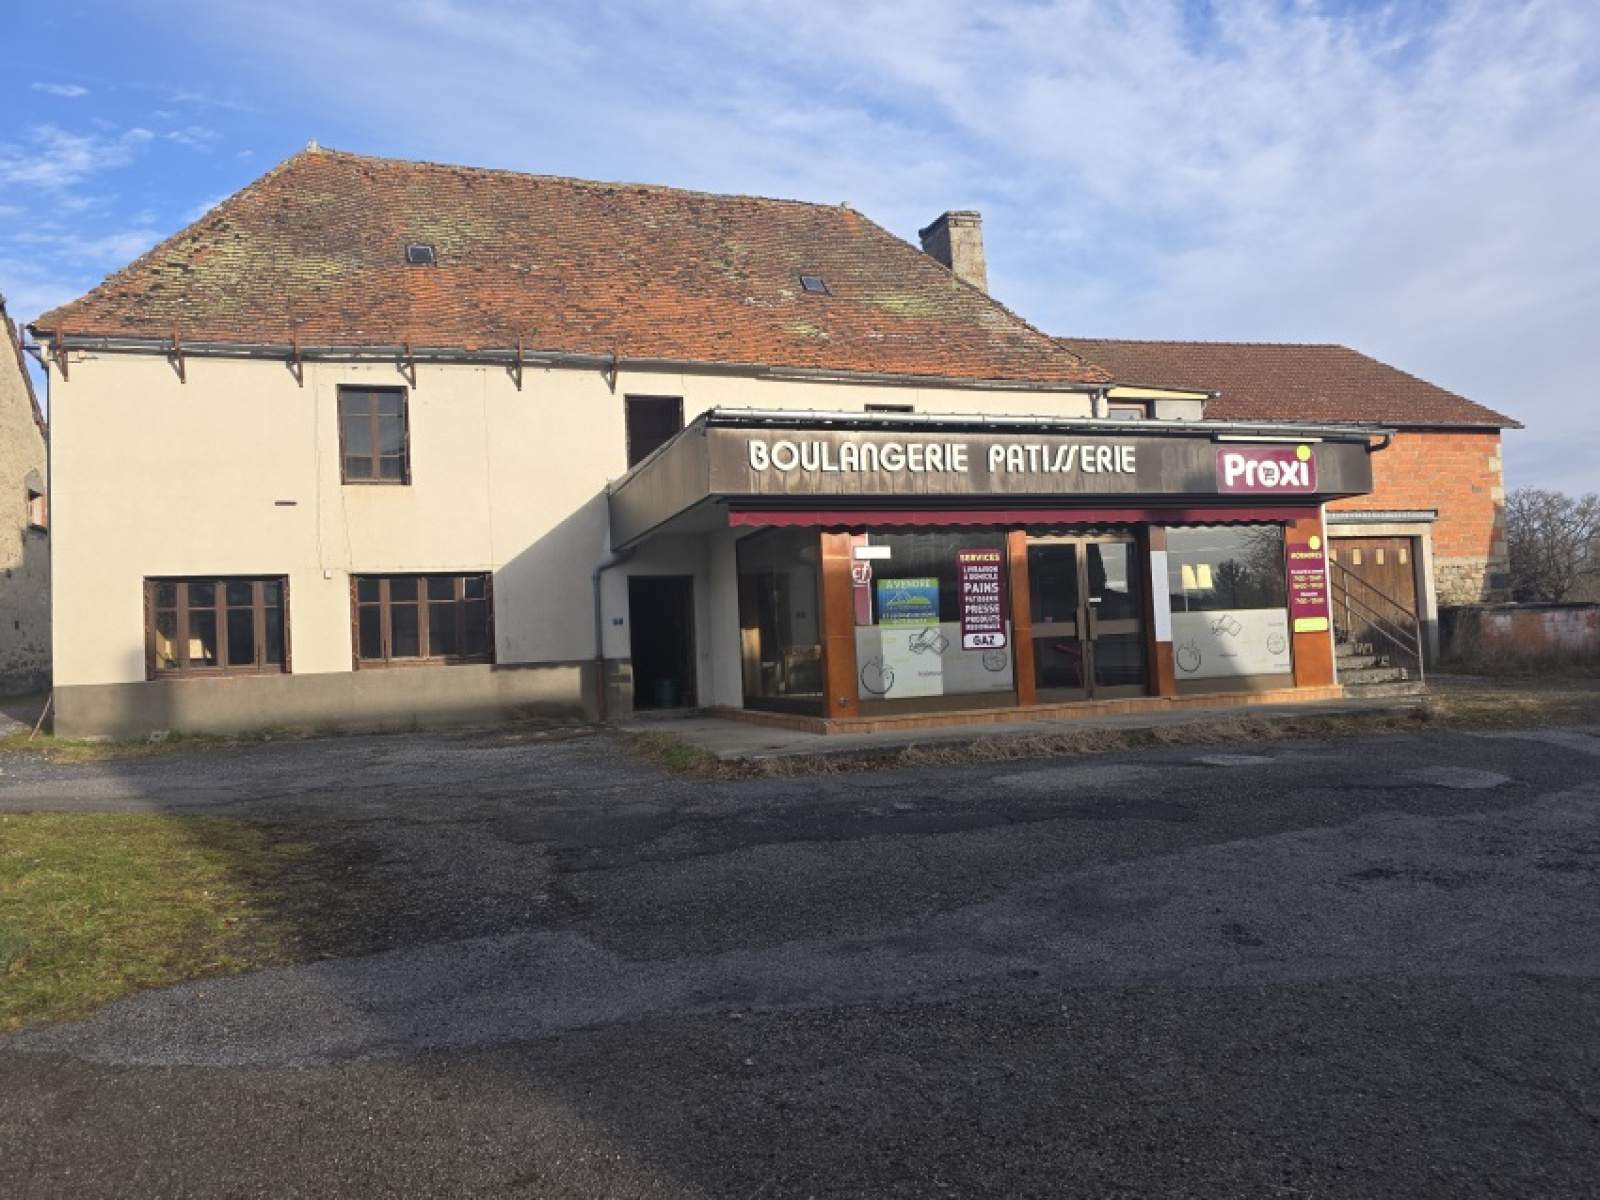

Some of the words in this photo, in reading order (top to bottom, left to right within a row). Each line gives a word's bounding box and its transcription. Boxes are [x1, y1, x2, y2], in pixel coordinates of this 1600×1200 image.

[749, 439, 969, 474] BOULANGERIE
[987, 443, 1137, 475] PATISSERIE
[1223, 445, 1311, 487] Proxi
[959, 553, 1001, 563] SERVICES
[894, 578, 931, 589] VENDRE
[963, 581, 999, 594] PAINS
[965, 603, 1000, 614] PRESSE
[965, 614, 1000, 624] PRODUITS
[973, 635, 995, 646] GAZ
